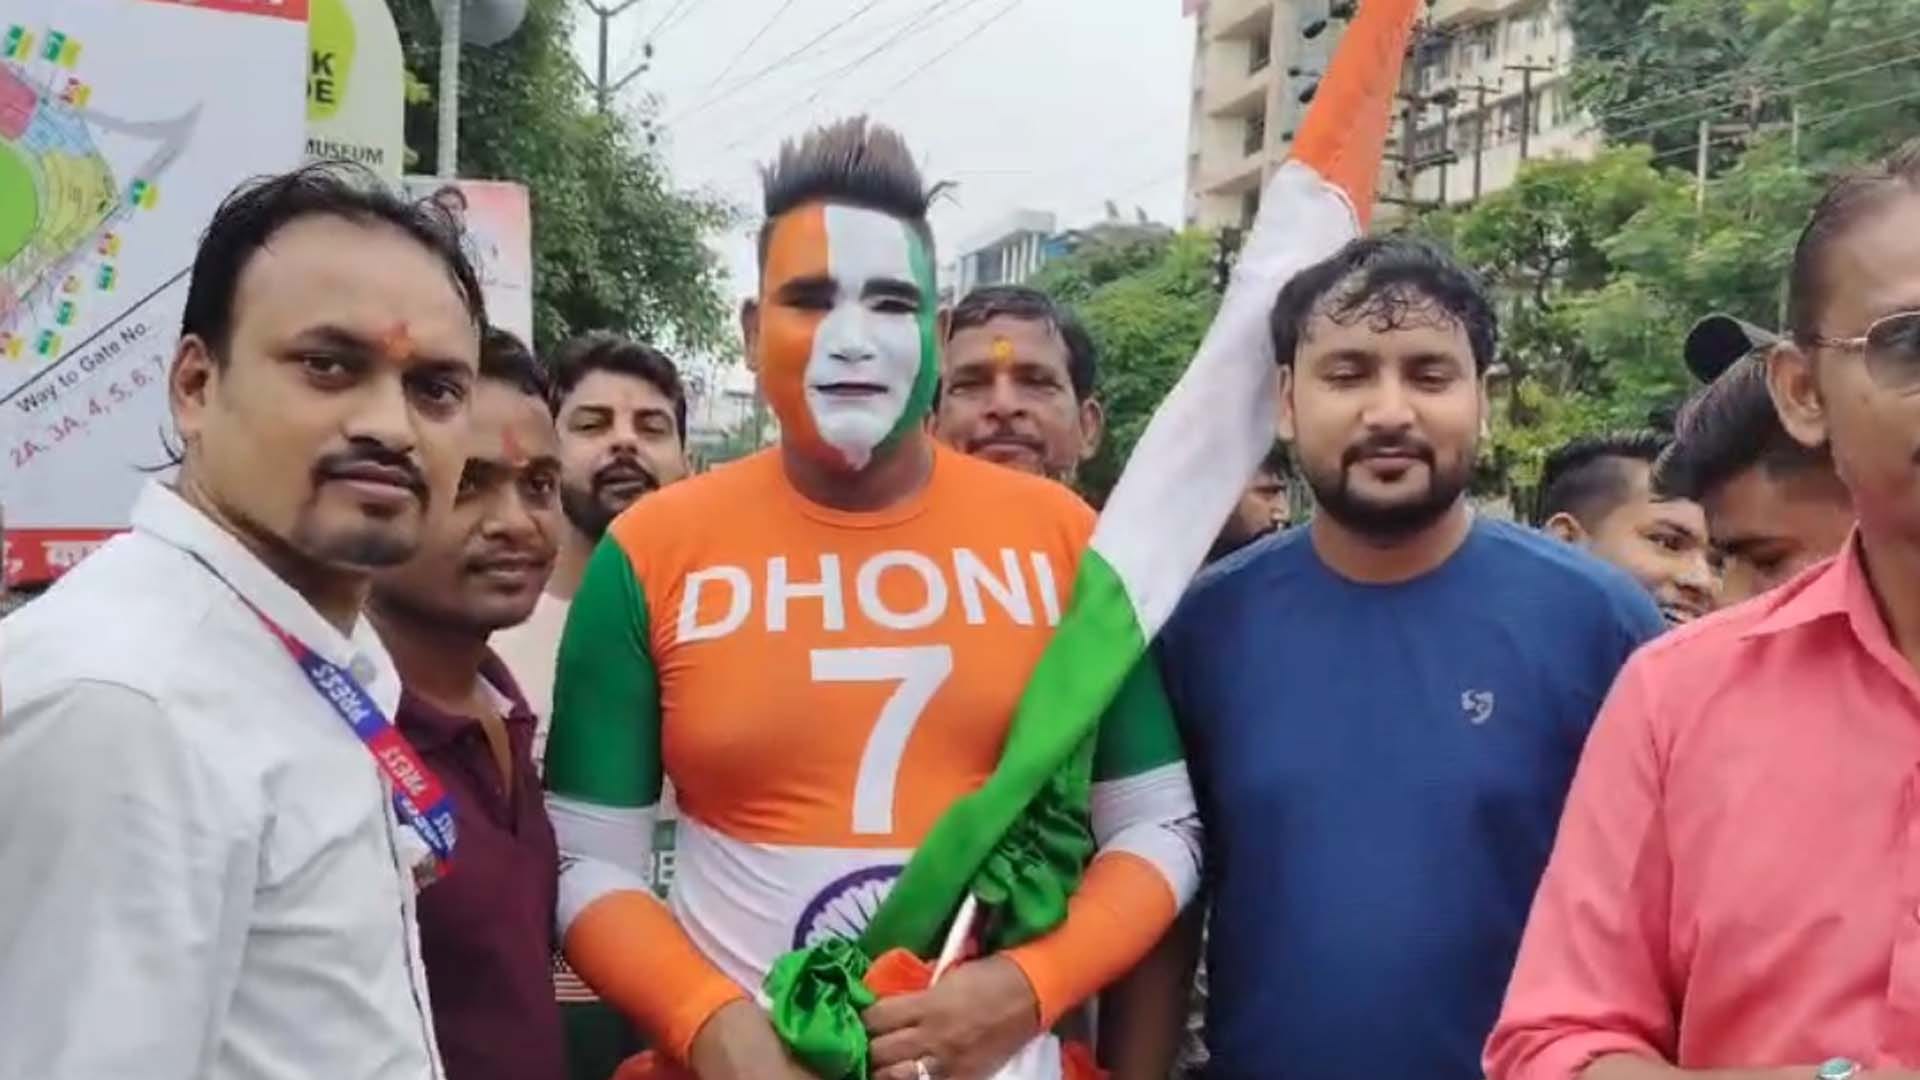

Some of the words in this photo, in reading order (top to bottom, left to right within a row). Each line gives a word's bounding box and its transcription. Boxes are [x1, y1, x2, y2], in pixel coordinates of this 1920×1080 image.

[307, 79, 335, 104] E
[15, 384, 59, 413] Way
[58, 370, 79, 387] to
[80, 341, 121, 372] Gate
[676, 548, 1062, 643] DHONI
[313, 664, 371, 724] PRESS
[378, 746, 427, 796] PRESS
[809, 644, 953, 834] 7
